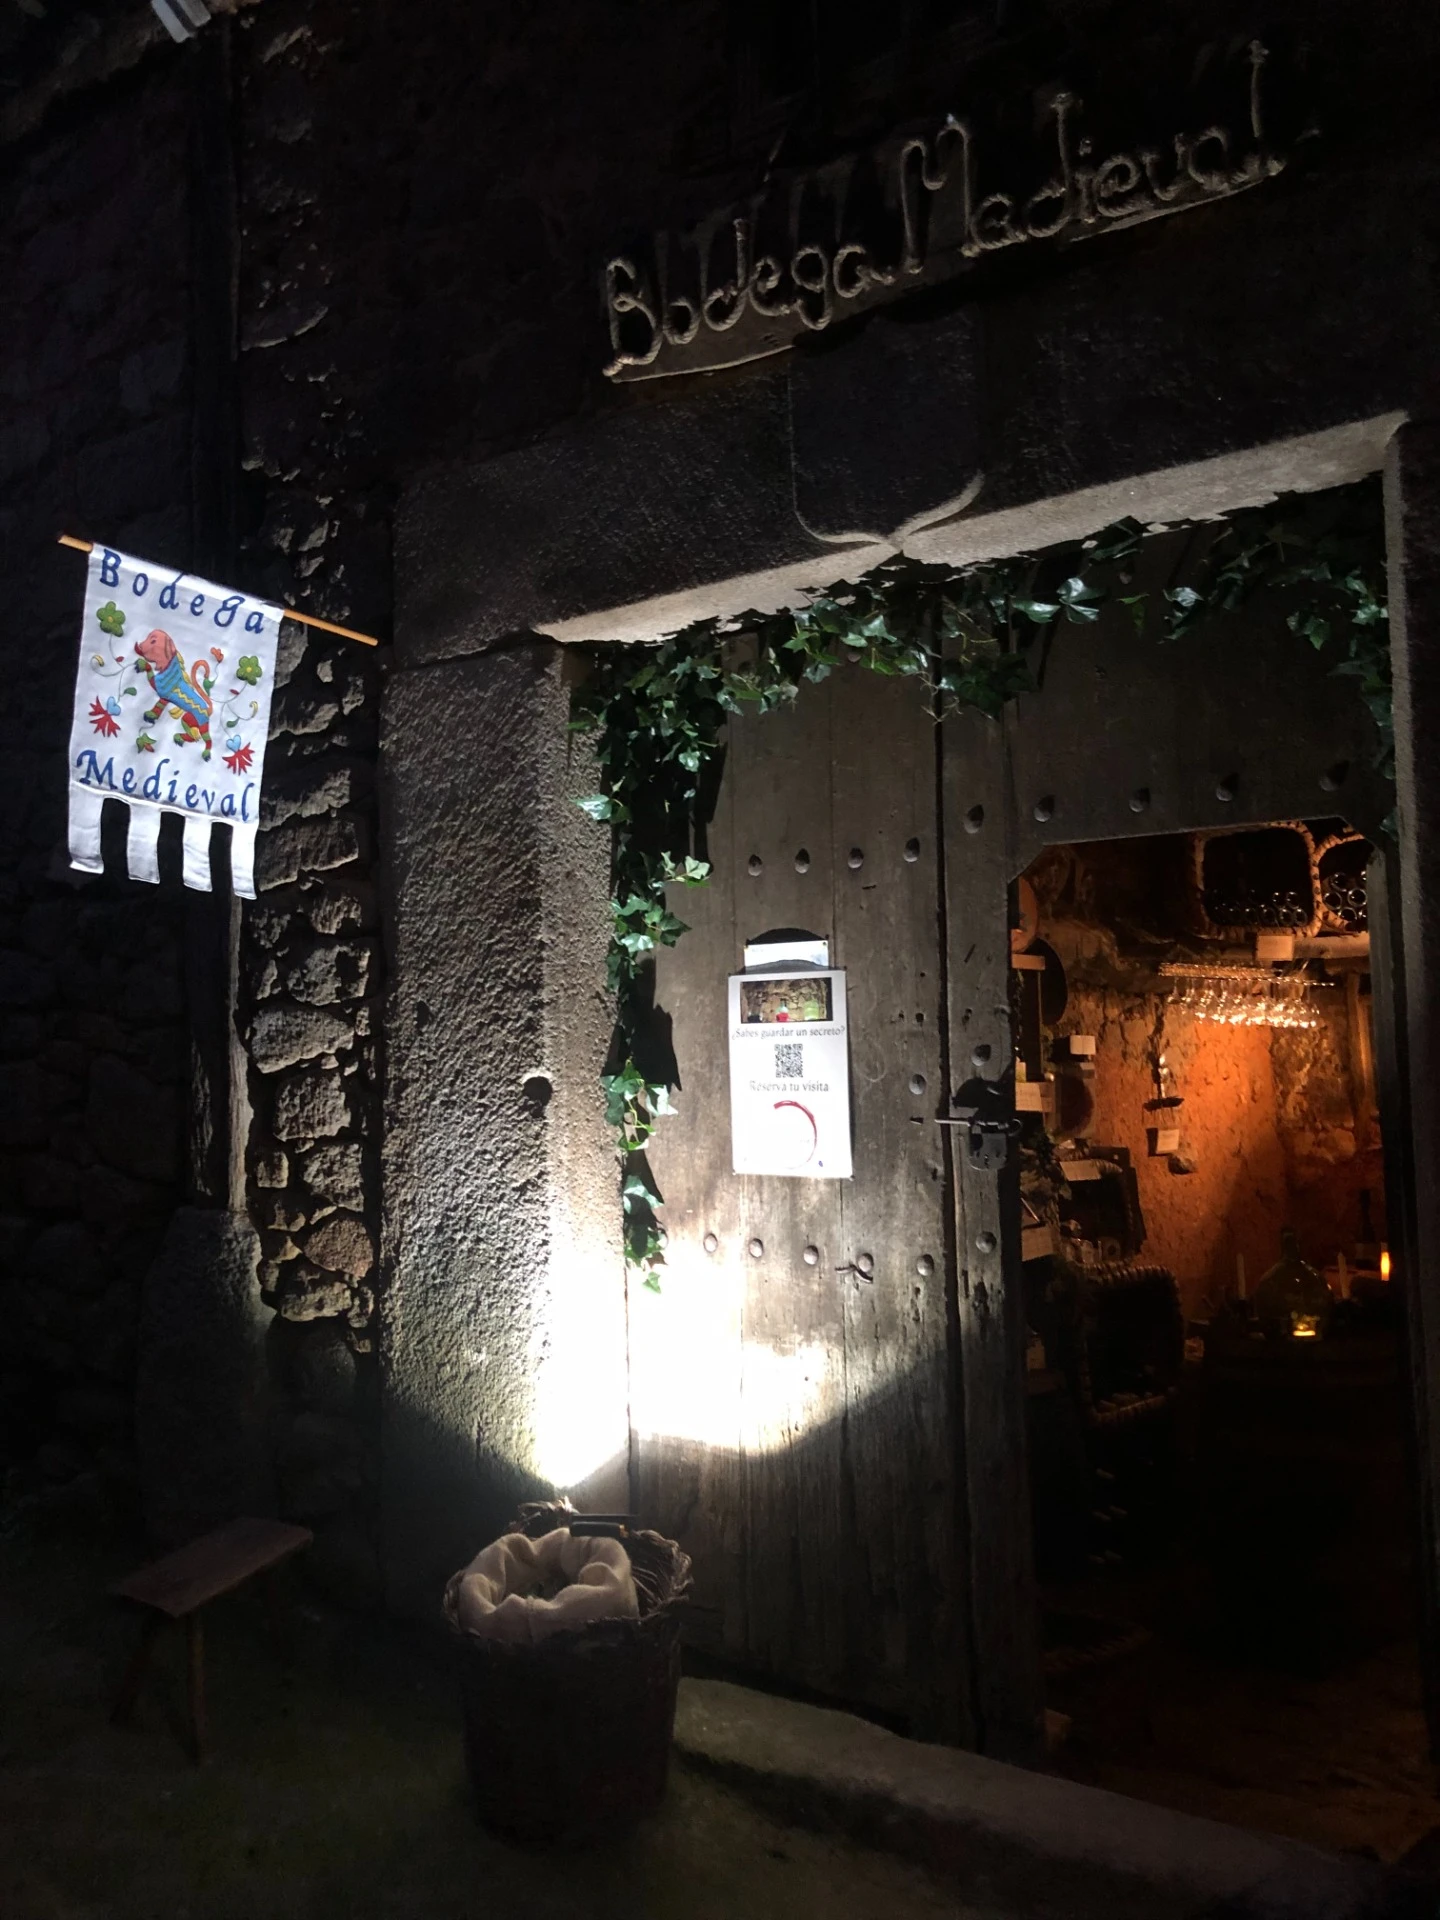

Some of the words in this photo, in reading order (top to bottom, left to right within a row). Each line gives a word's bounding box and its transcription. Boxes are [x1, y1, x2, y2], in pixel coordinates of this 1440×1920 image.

[602, 218, 896, 377] Bodega
[900, 38, 1289, 276] Medieval
[100, 548, 265, 634] Bodega
[76, 750, 256, 822] Medieval
[761, 1027, 794, 1039] guardar
[796, 1027, 808, 1037] un
[810, 1025, 845, 1037] secreto?
[789, 1082, 800, 1092] tu
[802, 1080, 829, 1092] visita
